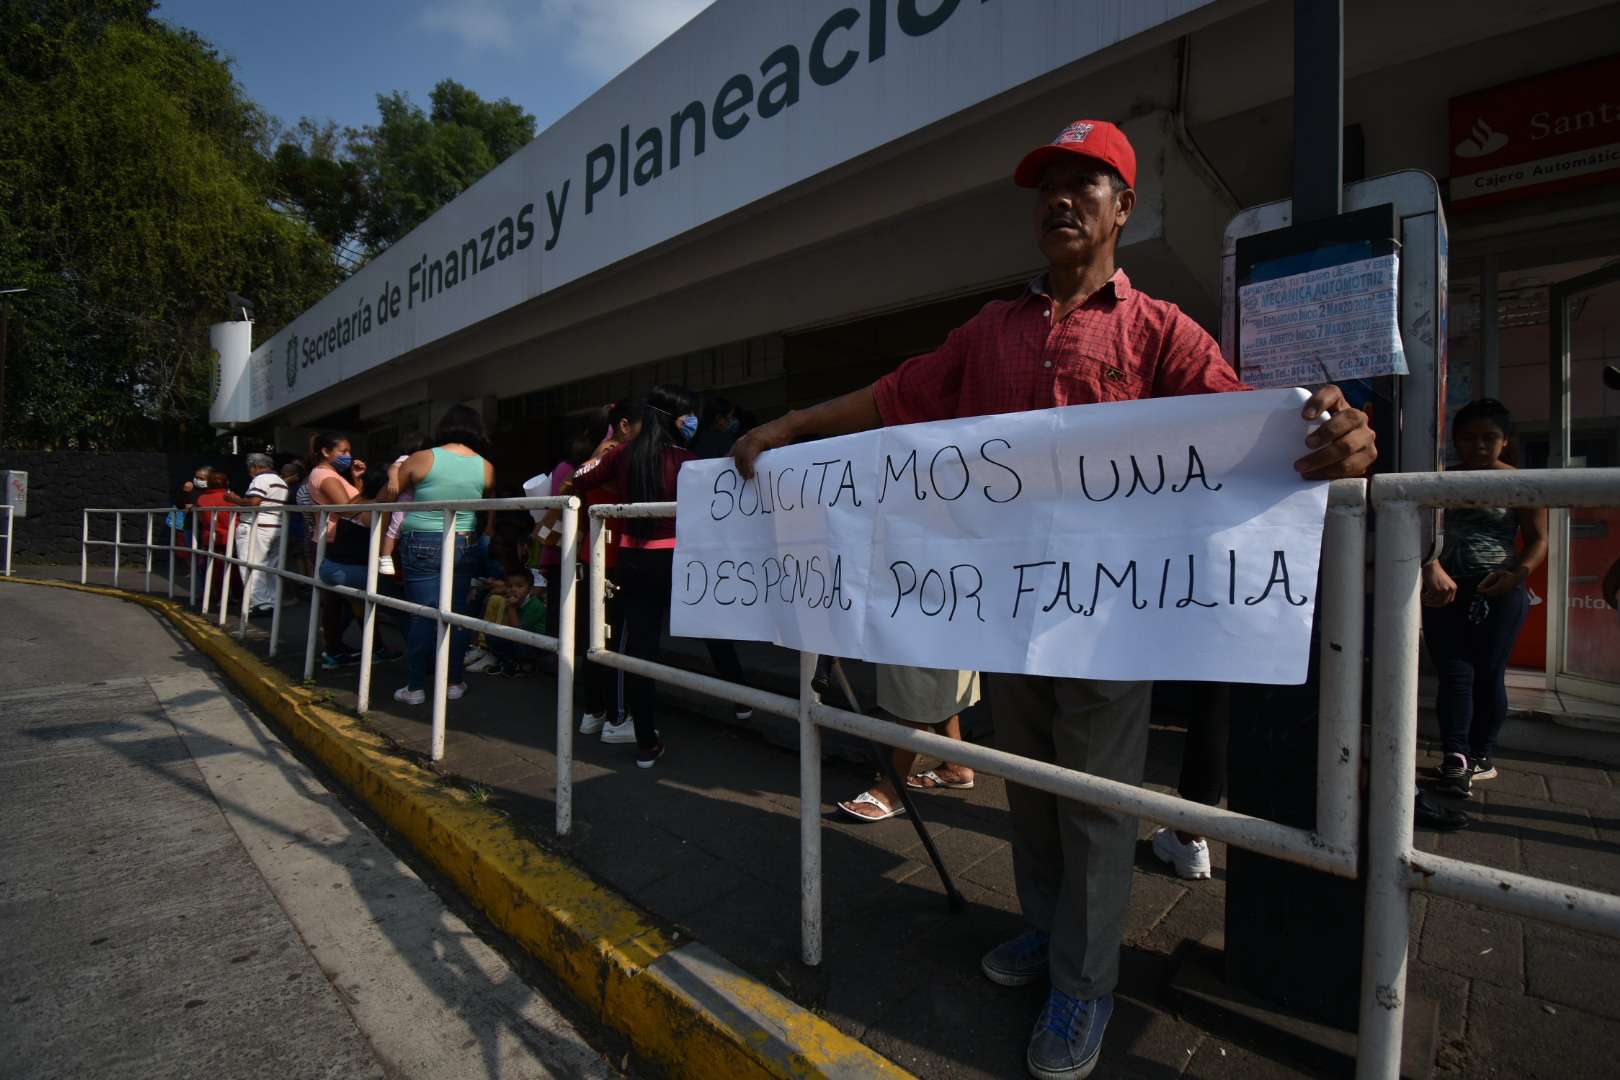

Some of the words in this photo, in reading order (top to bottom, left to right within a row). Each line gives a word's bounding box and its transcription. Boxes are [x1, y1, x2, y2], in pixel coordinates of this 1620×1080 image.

[1474, 171, 1524, 188] Cajero
[1532, 150, 1620, 177] Automátic
[301, 297, 372, 369] Secretaría
[377, 281, 401, 326] de
[408, 203, 535, 310] Finanzas
[544, 178, 571, 252] y
[585, 0, 988, 216] Planeaci
[1289, 278, 1299, 286] TU
[1301, 271, 1330, 284] TIEMPO
[1313, 271, 1384, 297] AUTOMOTRIZ
[1318, 305, 1326, 318] 2
[1354, 298, 1372, 312] 2020
[1317, 324, 1324, 338] 7
[1352, 318, 1370, 332] 2020
[1243, 371, 1273, 383] Informes
[1078, 445, 1223, 502] UNA
[682, 553, 853, 612] DESPENSA
[889, 560, 986, 622] POR
[1011, 548, 1309, 619] FAMILIA
